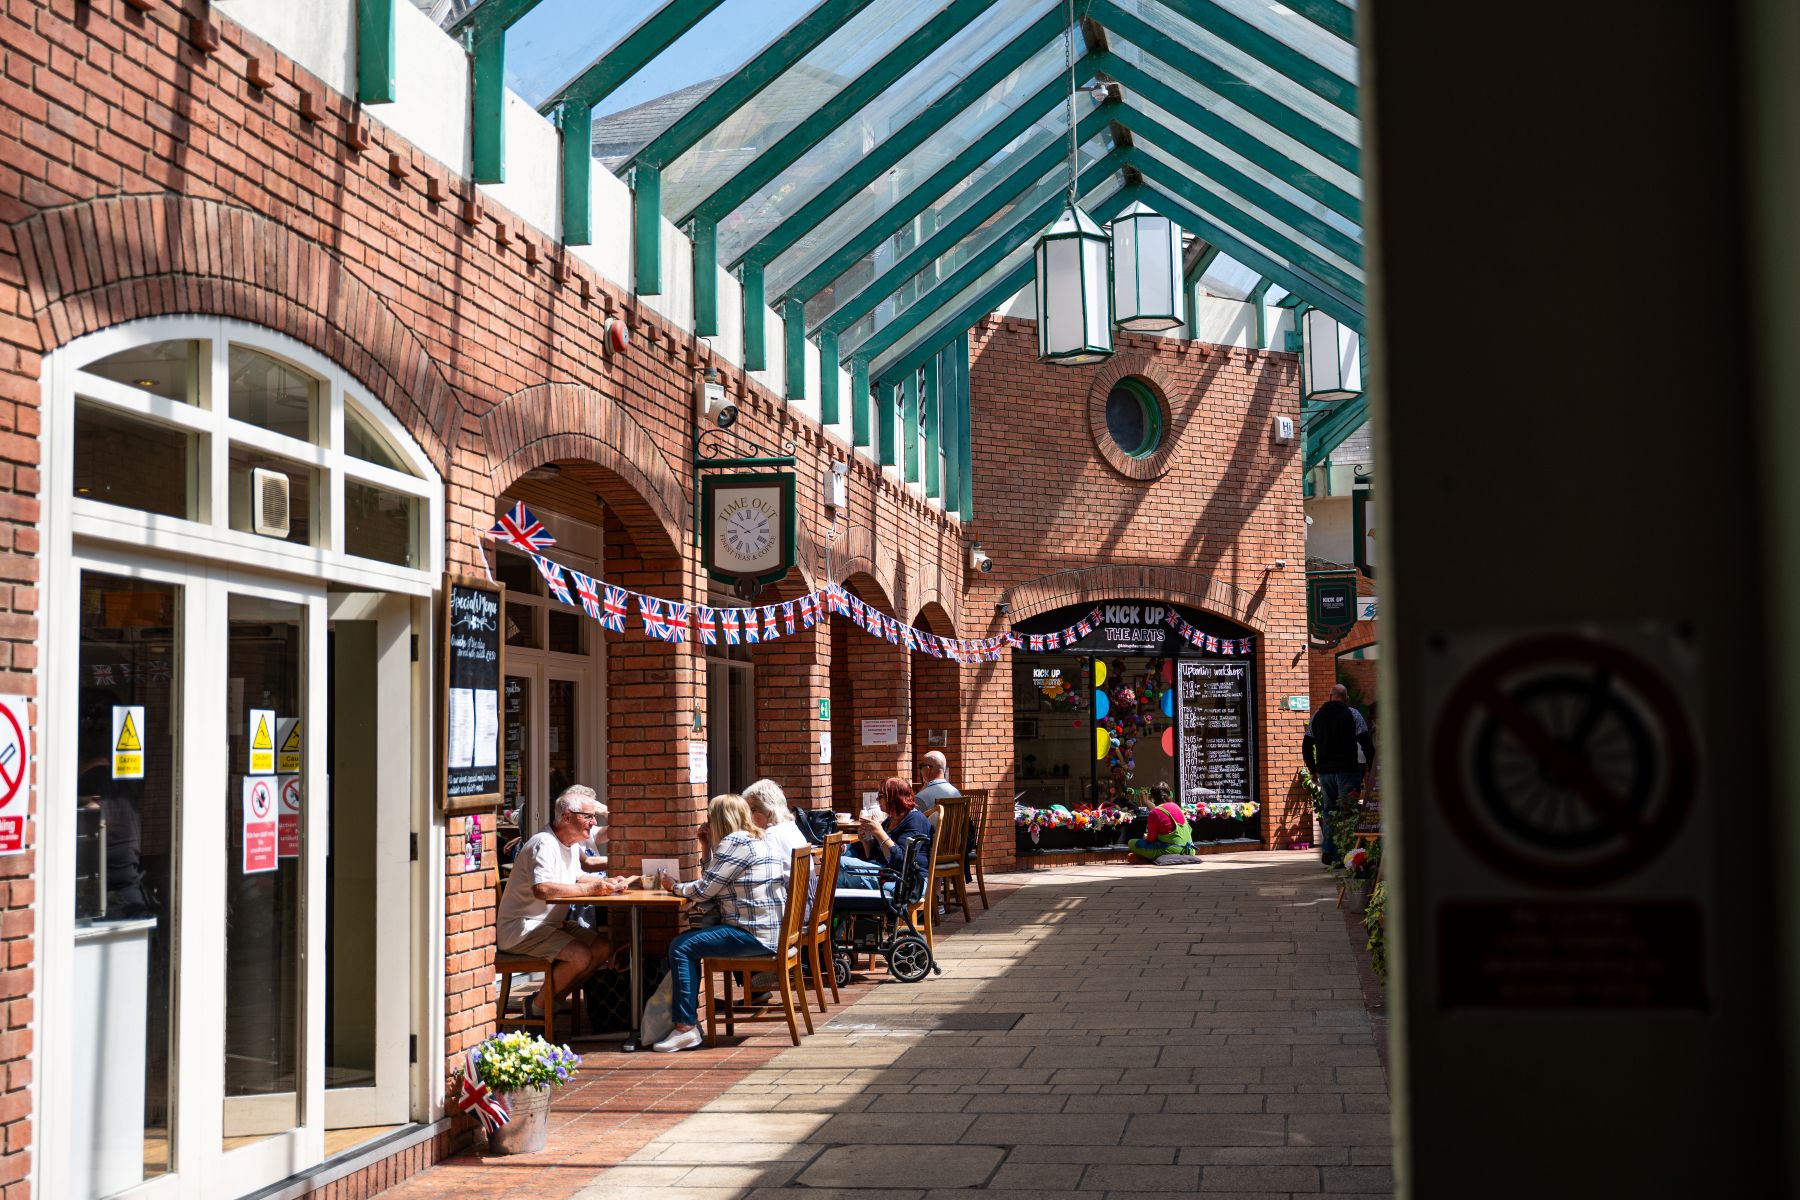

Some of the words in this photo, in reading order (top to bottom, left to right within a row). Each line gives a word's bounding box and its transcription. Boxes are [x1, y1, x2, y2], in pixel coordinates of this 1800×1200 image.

[719, 497, 748, 521] TIME
[752, 498, 778, 519] OUT
[720, 534, 734, 555] FINEST
[735, 552, 751, 561] TEAS
[1105, 605, 1140, 624] KICK
[1144, 606, 1165, 625] UP
[1105, 628, 1130, 641] THE
[1132, 628, 1166, 642] ARTS
[1033, 668, 1050, 678] KICK
[1051, 669, 1061, 678] UP
[1182, 664, 1212, 679] Upcoming
[1213, 665, 1244, 680] workshops
